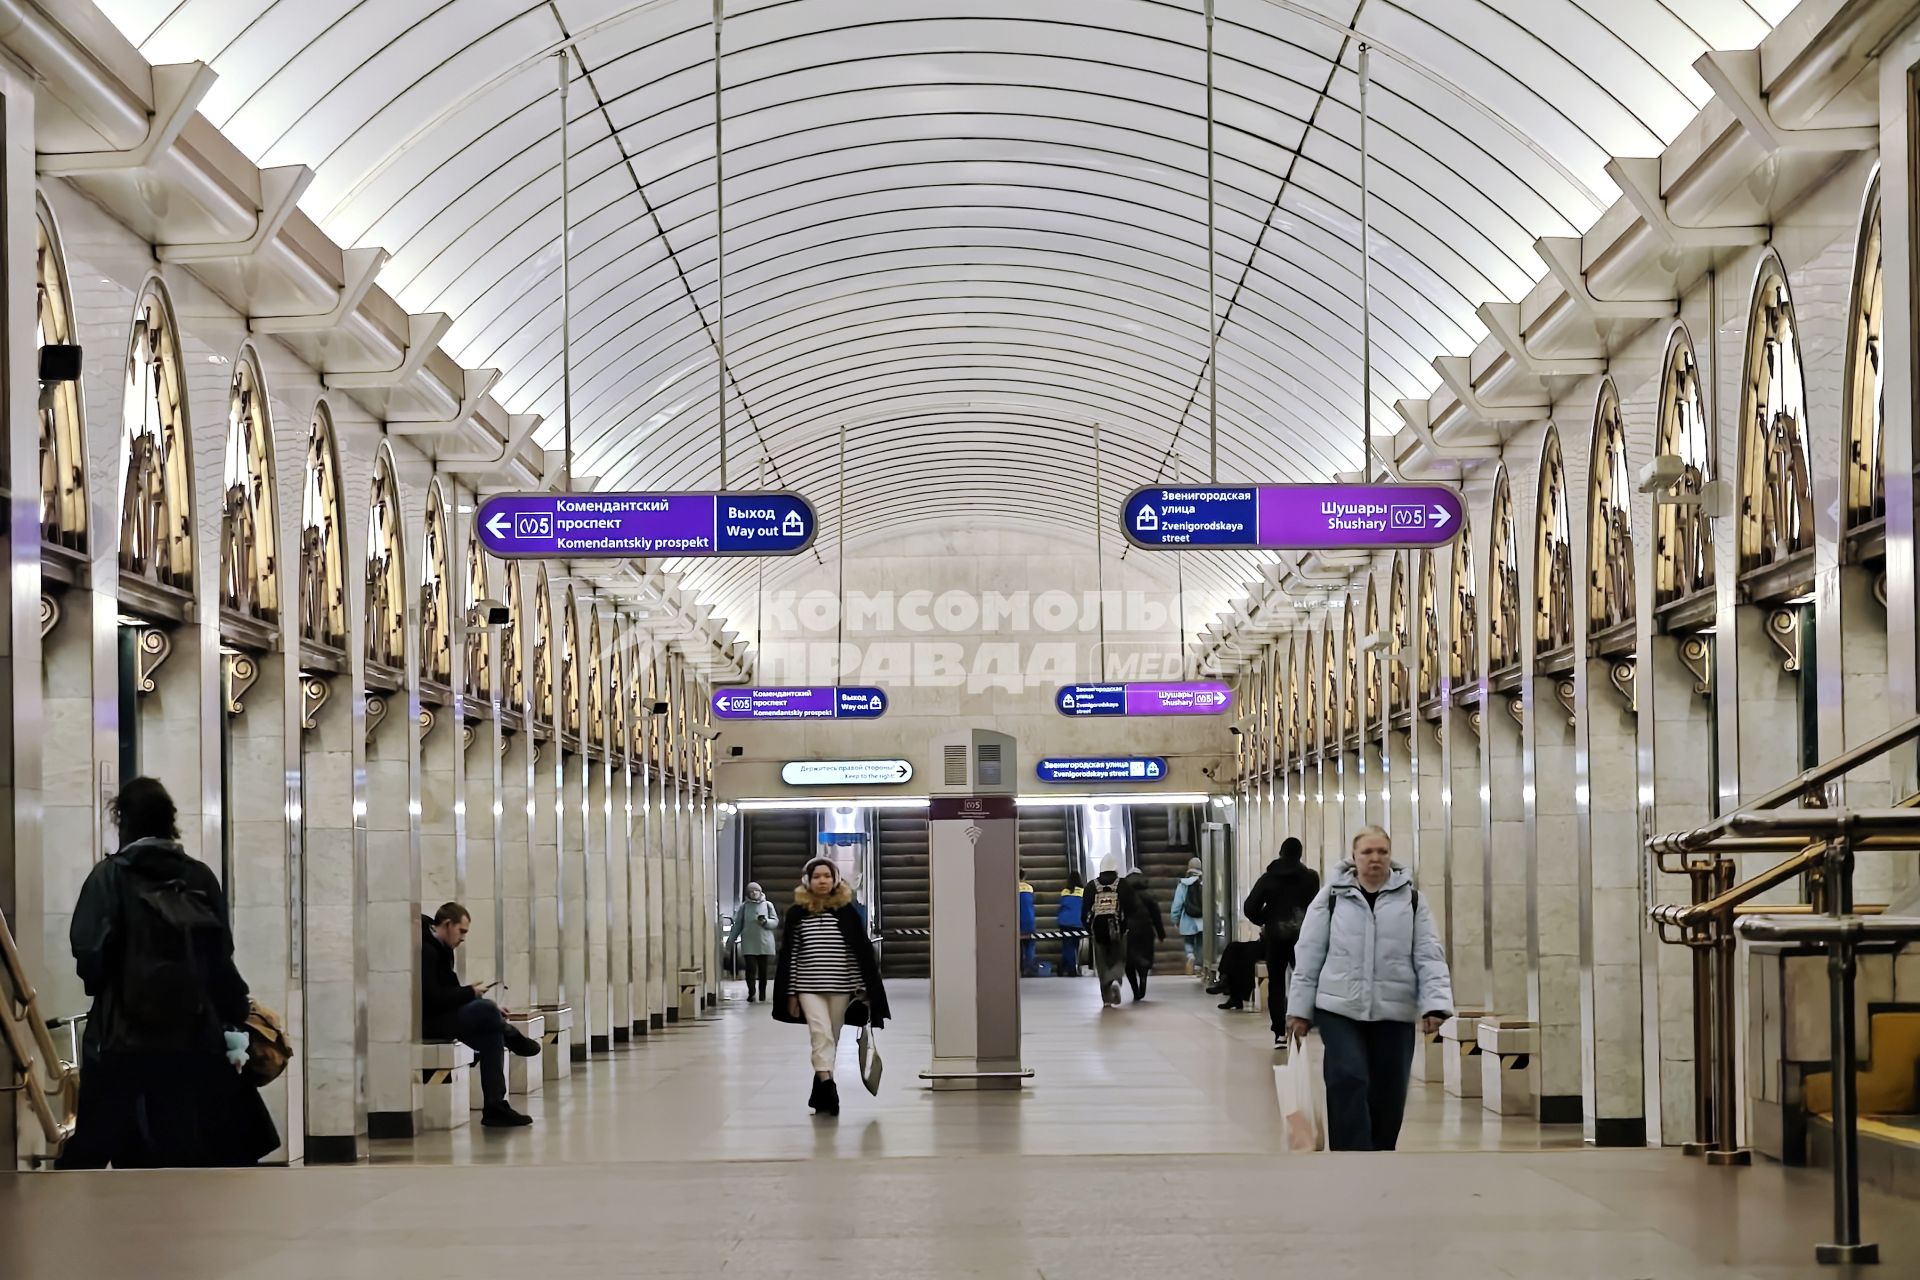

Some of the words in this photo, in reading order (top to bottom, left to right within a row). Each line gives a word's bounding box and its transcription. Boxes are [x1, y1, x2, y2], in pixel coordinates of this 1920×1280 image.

[1161, 491, 1251, 502] Звенигородская
[556, 499, 669, 513] Комендантский
[1161, 505, 1196, 516] улица
[1321, 502, 1388, 517] Шушары
[728, 507, 776, 520] Выход
[557, 519, 622, 531] проспект
[1161, 521, 1244, 532] Zvenigorodskaya
[1328, 517, 1387, 531] Shushary
[726, 526, 755, 539] Way
[757, 526, 779, 537] out
[557, 536, 652, 550] Komendantskiy
[654, 536, 709, 550] prospekt
[1161, 534, 1190, 543] street
[841, 693, 867, 701] Выход
[1158, 691, 1194, 701] Шушары
[752, 699, 788, 707] проспект
[841, 703, 857, 711] Way
[1162, 699, 1194, 707] Shushary
